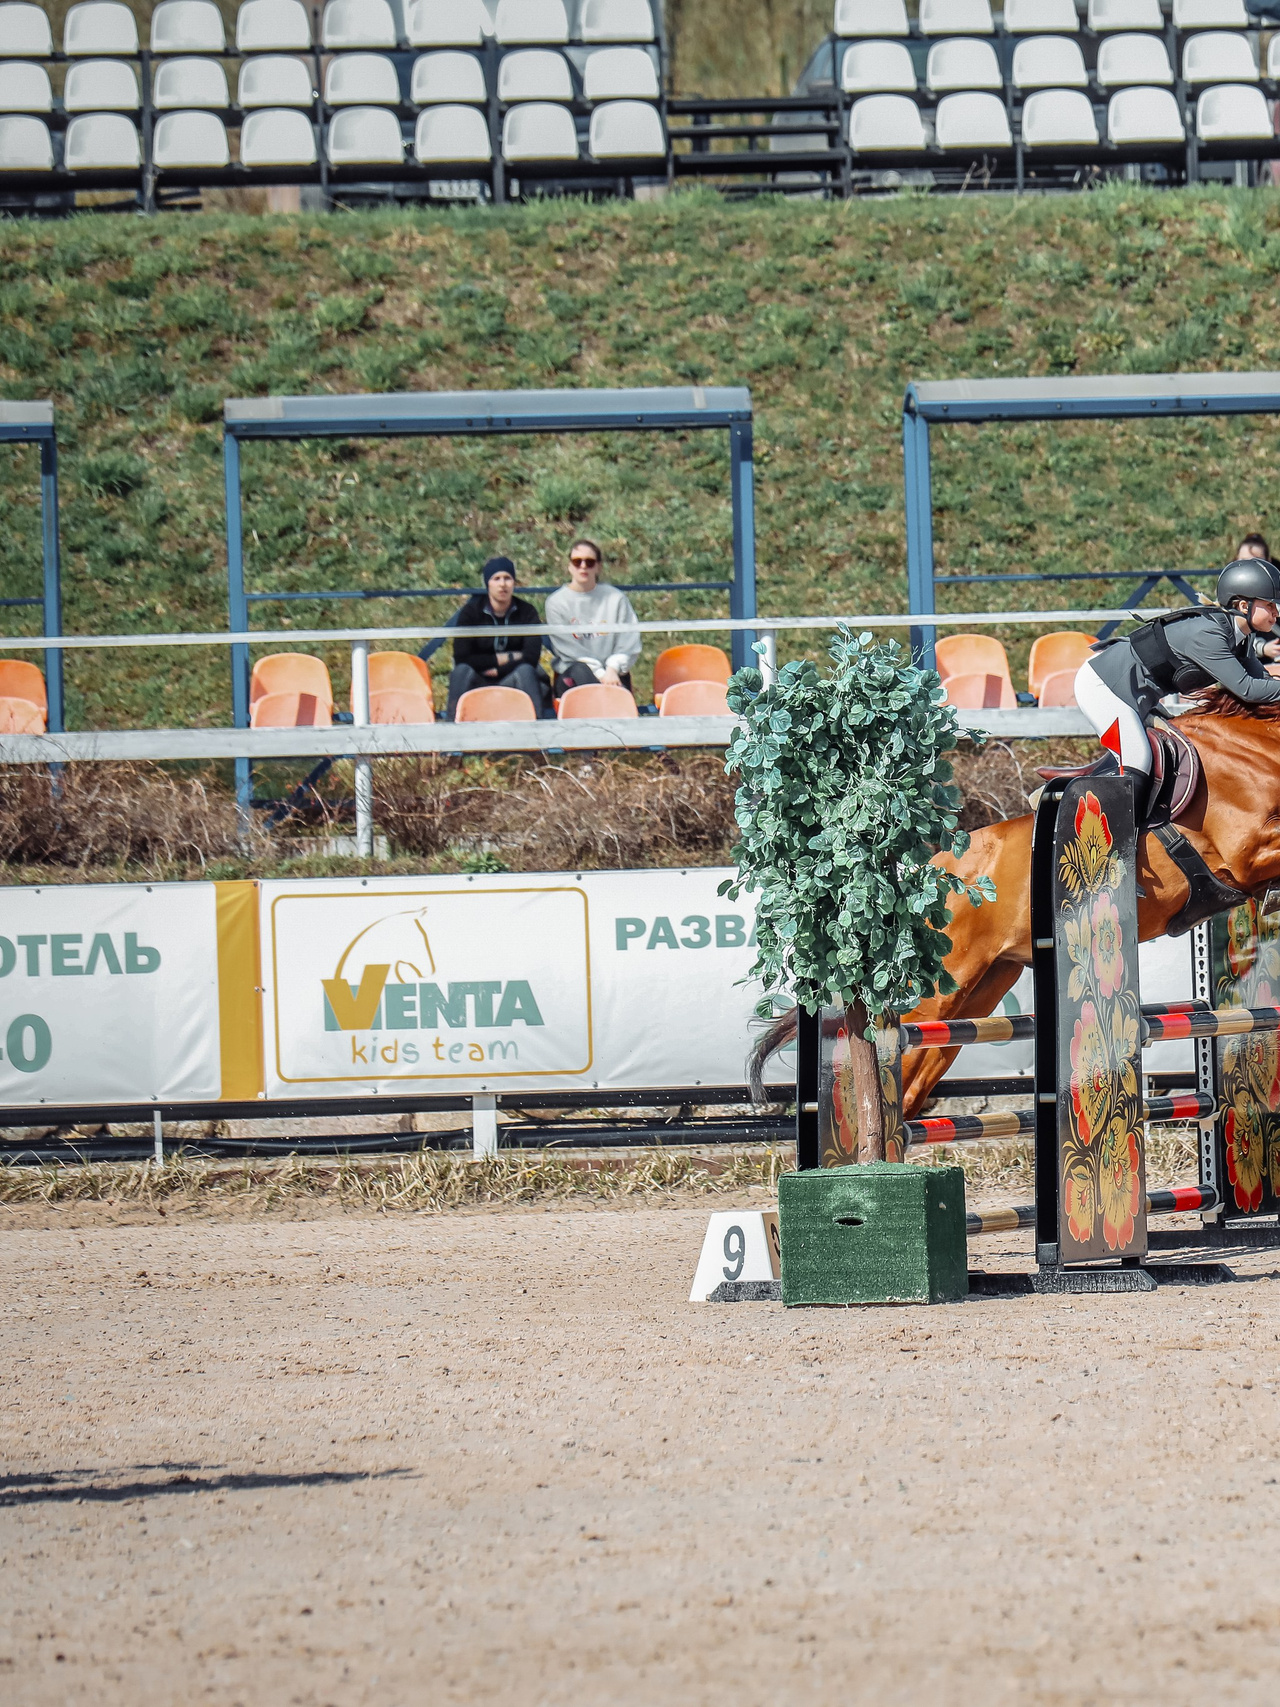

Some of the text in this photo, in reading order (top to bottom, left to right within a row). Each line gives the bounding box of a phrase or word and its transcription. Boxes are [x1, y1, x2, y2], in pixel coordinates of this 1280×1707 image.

[615, 914, 757, 951] РАЗВ
[321, 964, 545, 1032] VENTA
[351, 1034, 519, 1065] kids team
[722, 1225, 746, 1281] 9
